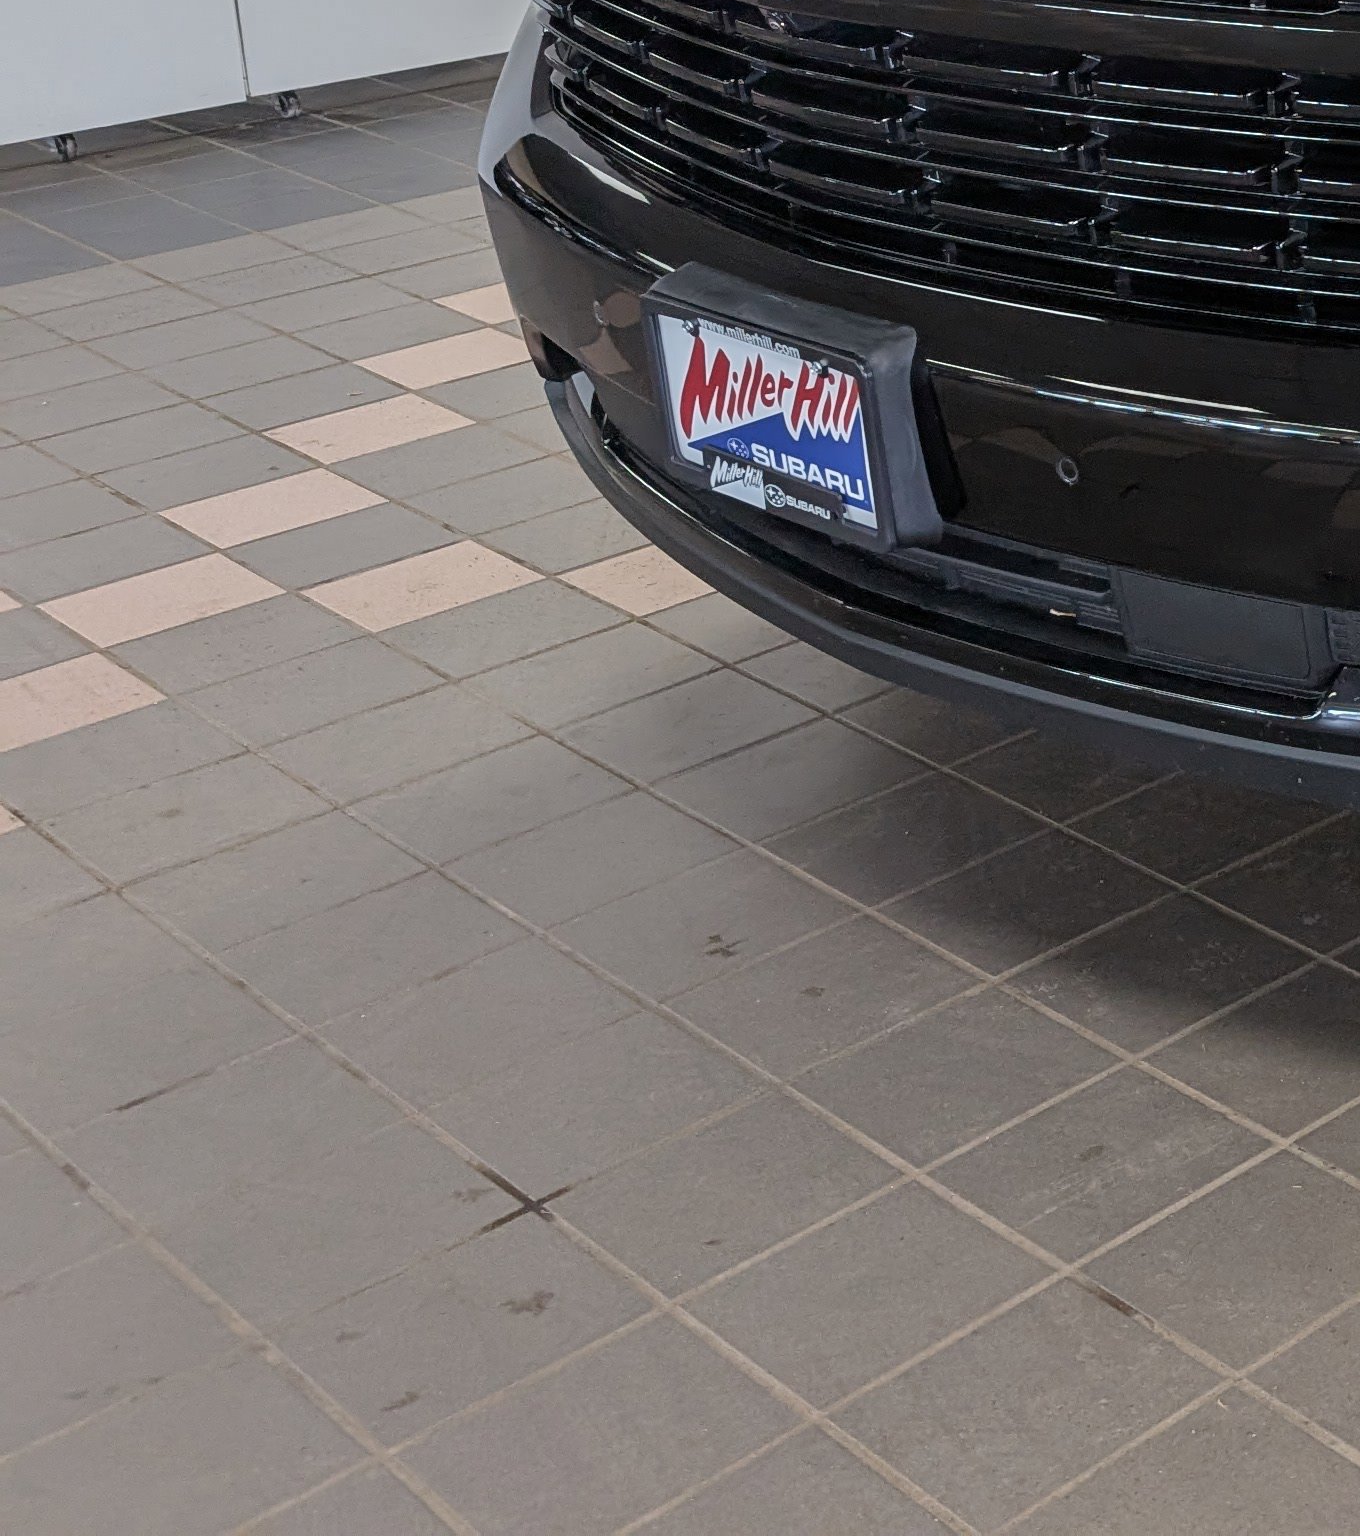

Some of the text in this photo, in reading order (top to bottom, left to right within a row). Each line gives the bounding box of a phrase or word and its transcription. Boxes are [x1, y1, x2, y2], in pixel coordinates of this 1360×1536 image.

[680, 336, 859, 439] Miller Hill
[710, 456, 764, 489] Miller Hill
[751, 443, 865, 501] SUBARU
[785, 495, 831, 520] SUBARU
